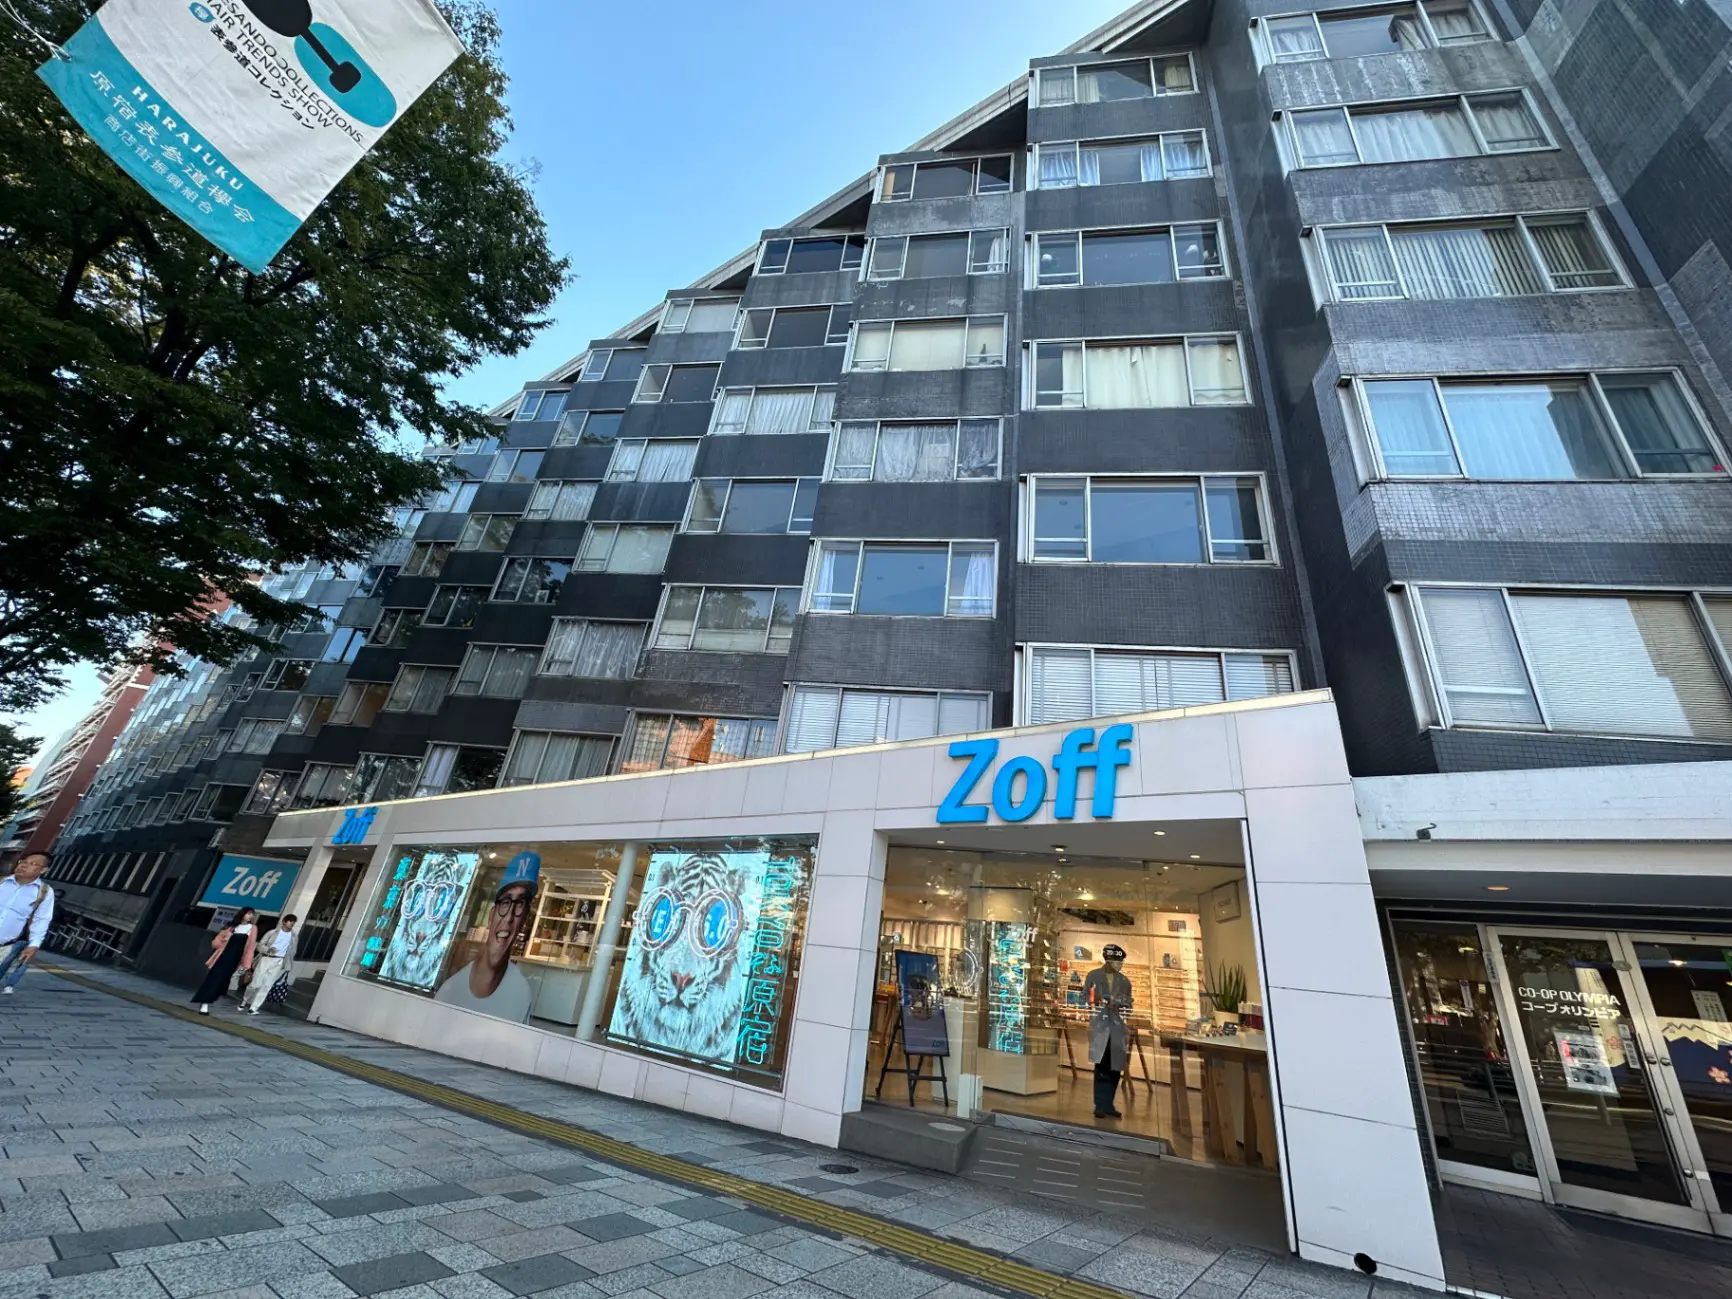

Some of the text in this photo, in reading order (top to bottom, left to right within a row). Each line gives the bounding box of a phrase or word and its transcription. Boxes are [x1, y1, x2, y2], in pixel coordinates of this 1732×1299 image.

[210, 23, 315, 130] 表参道コレクション
[237, 29, 289, 88] TRENDS
[288, 87, 333, 128] SHOW
[104, 113, 213, 215] 商店街振興組合
[132, 85, 243, 191] HARAJUKU
[936, 723, 1134, 824] Zoff
[331, 806, 379, 844] Zoff
[221, 866, 283, 899] Zoff
[515, 857, 531, 878] N
[1518, 987, 1621, 1006] CO-OP OLYMPIA
[1521, 1001, 1559, 1013] コープ
